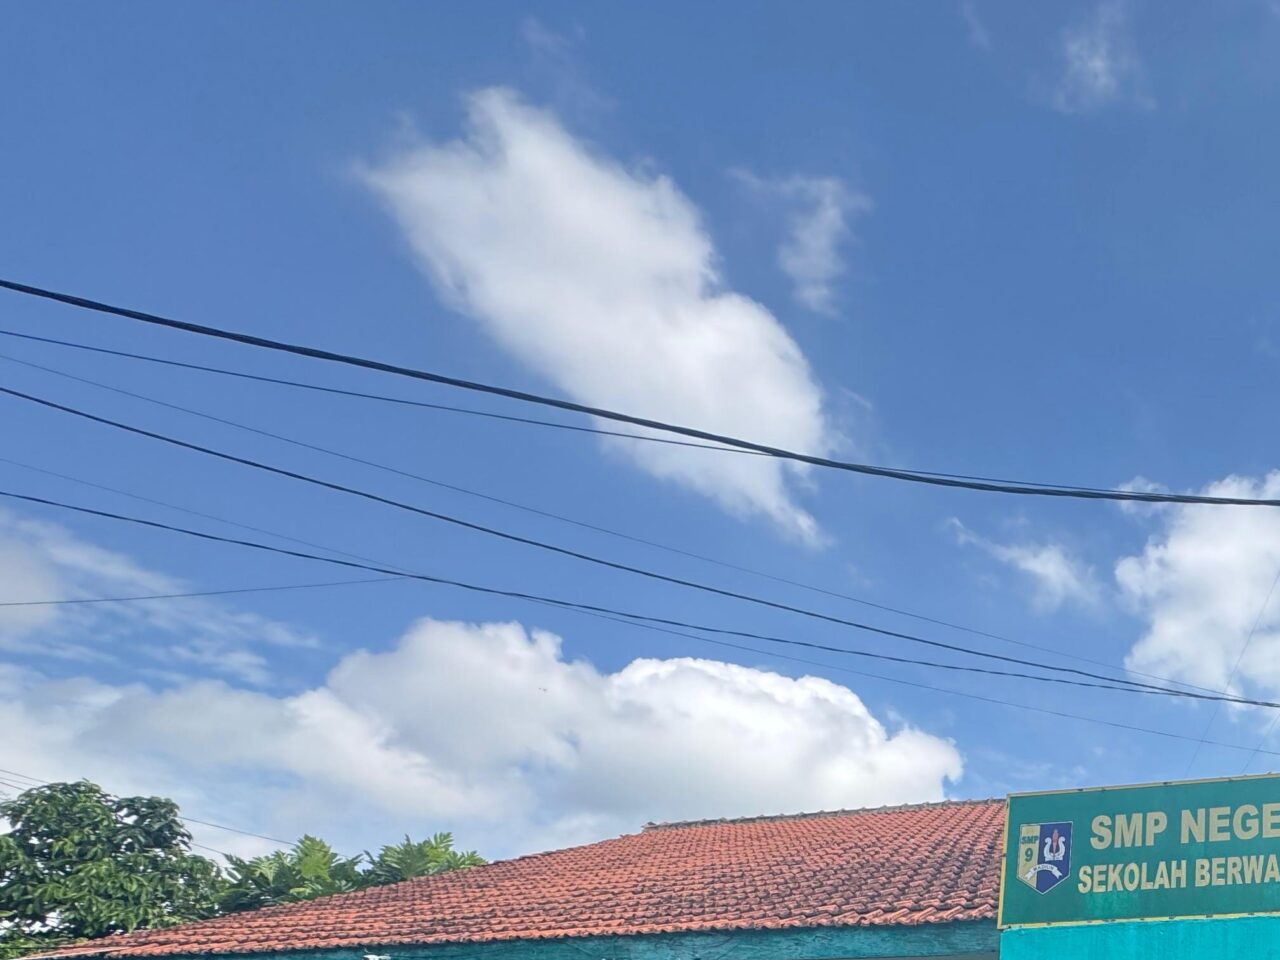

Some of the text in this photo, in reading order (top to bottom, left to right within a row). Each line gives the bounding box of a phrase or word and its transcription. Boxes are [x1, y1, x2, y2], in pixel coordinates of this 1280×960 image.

[1021, 835, 1039, 844] SMP
[1090, 811, 1168, 850] SMP
[1025, 847, 1034, 862] 9
[1077, 860, 1187, 894] SEKOLAH
